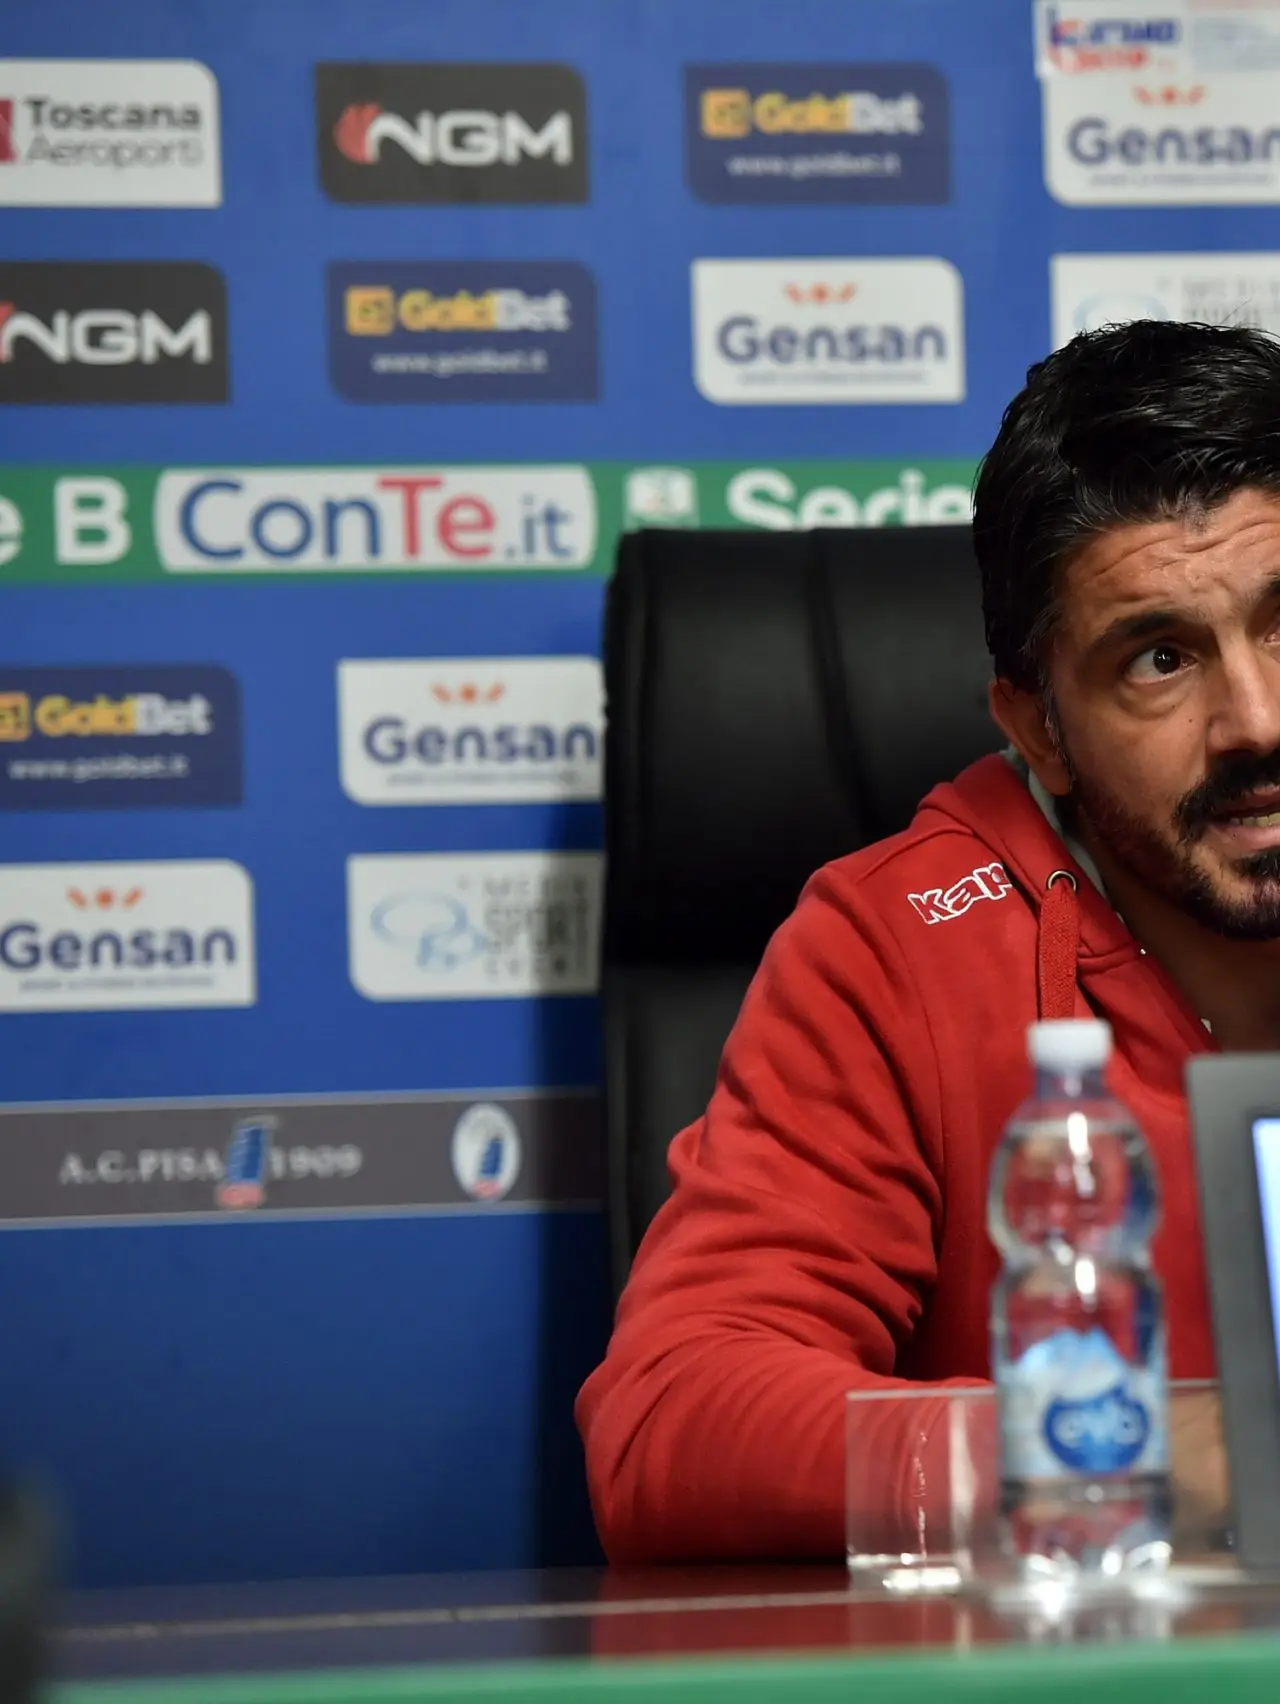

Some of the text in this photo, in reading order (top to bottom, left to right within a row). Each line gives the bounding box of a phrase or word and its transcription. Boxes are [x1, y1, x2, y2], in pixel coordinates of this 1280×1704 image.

[24, 97, 202, 130] Toscana
[364, 109, 574, 166] NGM
[753, 89, 923, 136] GoldBet
[398, 287, 573, 333] GoldBet
[2, 308, 211, 365] NGM
[716, 314, 948, 365] Gensan
[53, 476, 133, 566] B
[176, 475, 576, 562] ConTe.it
[33, 694, 213, 738] GoldBet
[361, 715, 598, 768] Gensan
[0, 921, 239, 971] Gensan
[267, 1143, 363, 1180] 1909
